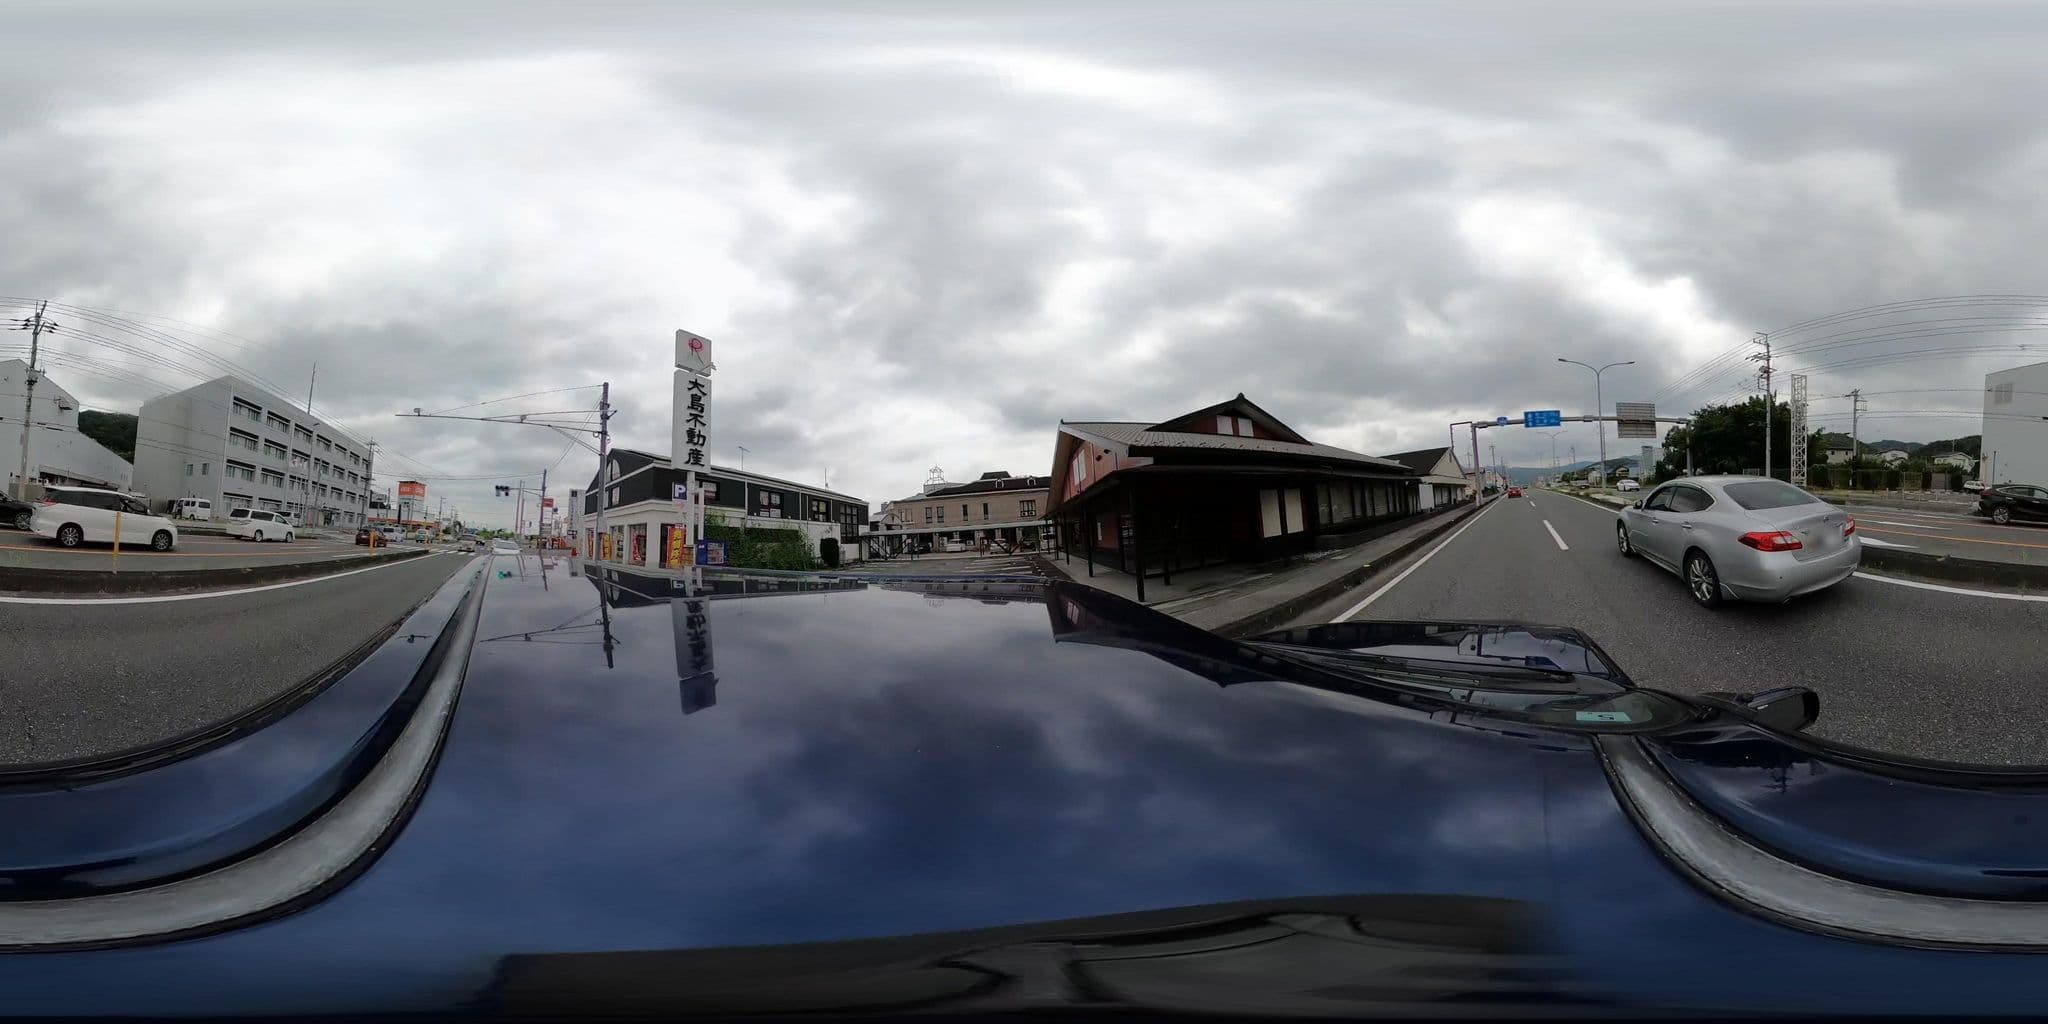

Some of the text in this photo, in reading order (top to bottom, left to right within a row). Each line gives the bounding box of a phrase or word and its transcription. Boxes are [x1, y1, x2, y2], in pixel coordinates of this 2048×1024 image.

[684, 378, 707, 467] 大島不動産
[675, 484, 686, 498] P
